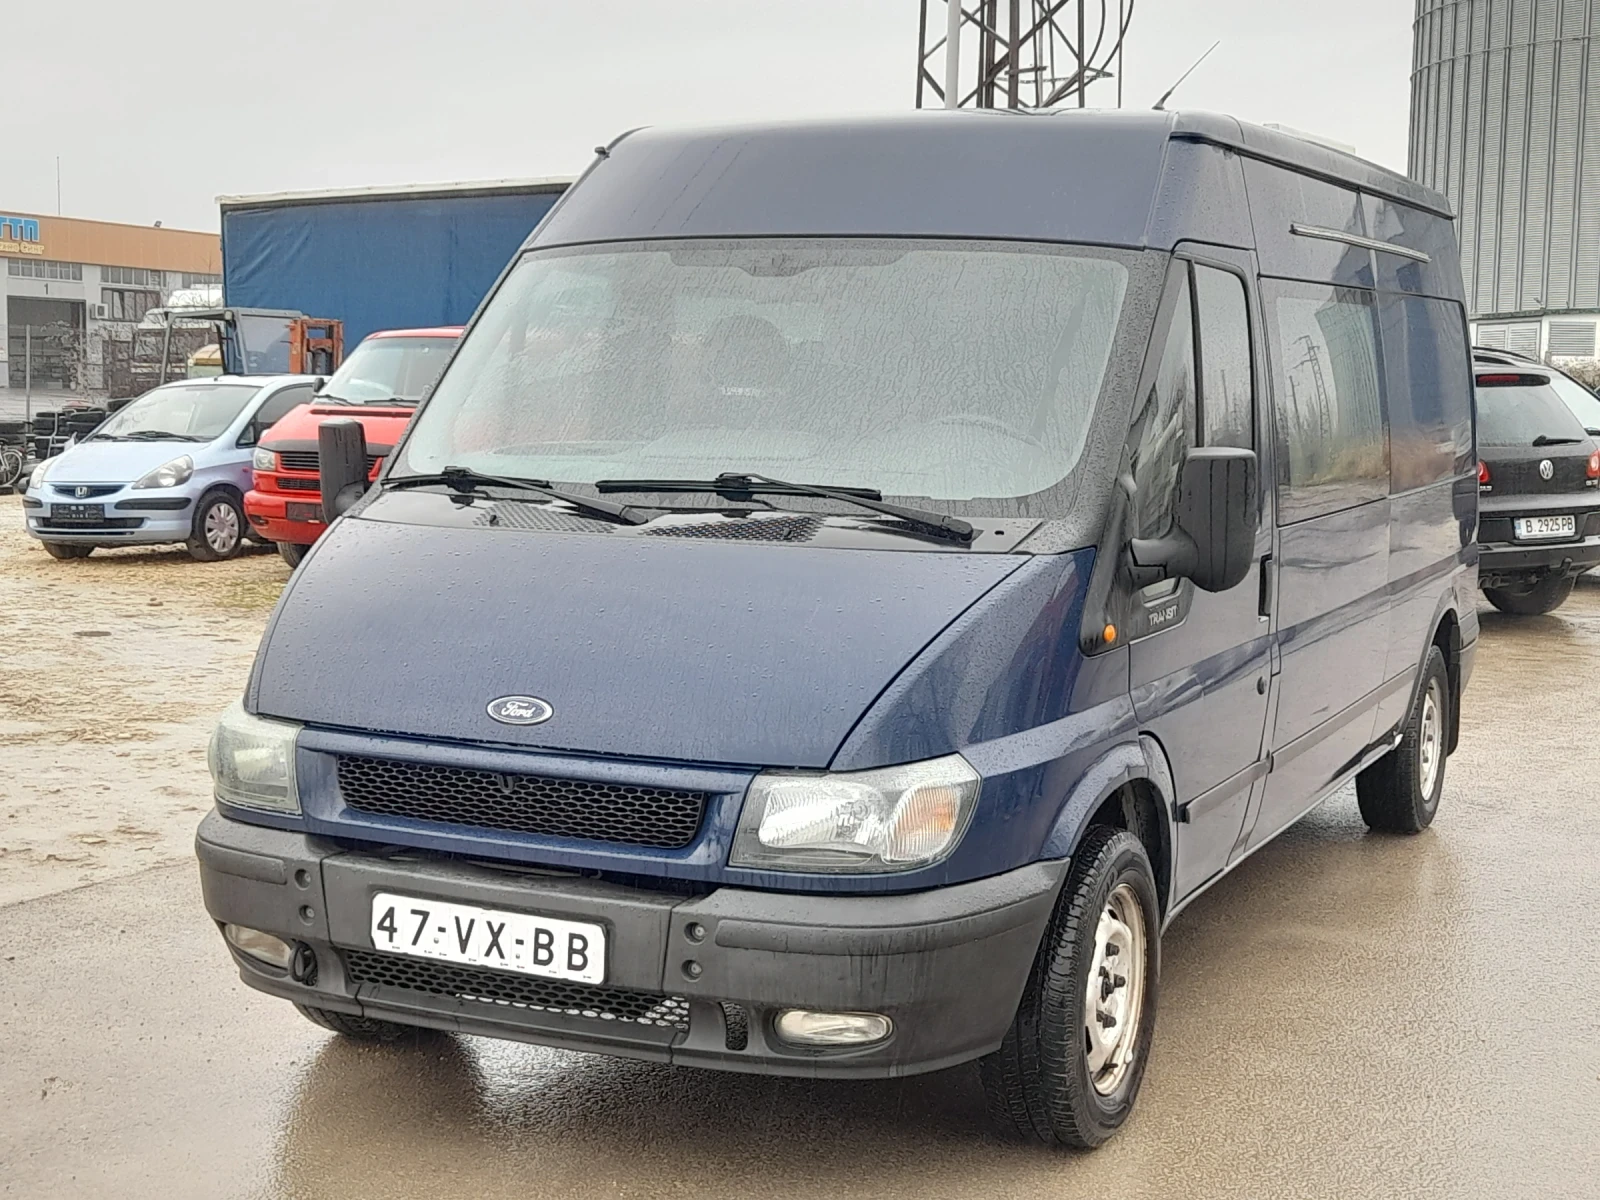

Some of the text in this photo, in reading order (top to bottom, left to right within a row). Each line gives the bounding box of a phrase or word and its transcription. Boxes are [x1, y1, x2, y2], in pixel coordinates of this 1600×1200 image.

[44, 283, 49, 295] 1
[501, 700, 537, 718] Ford
[376, 905, 589, 972] 47-VX-BB
